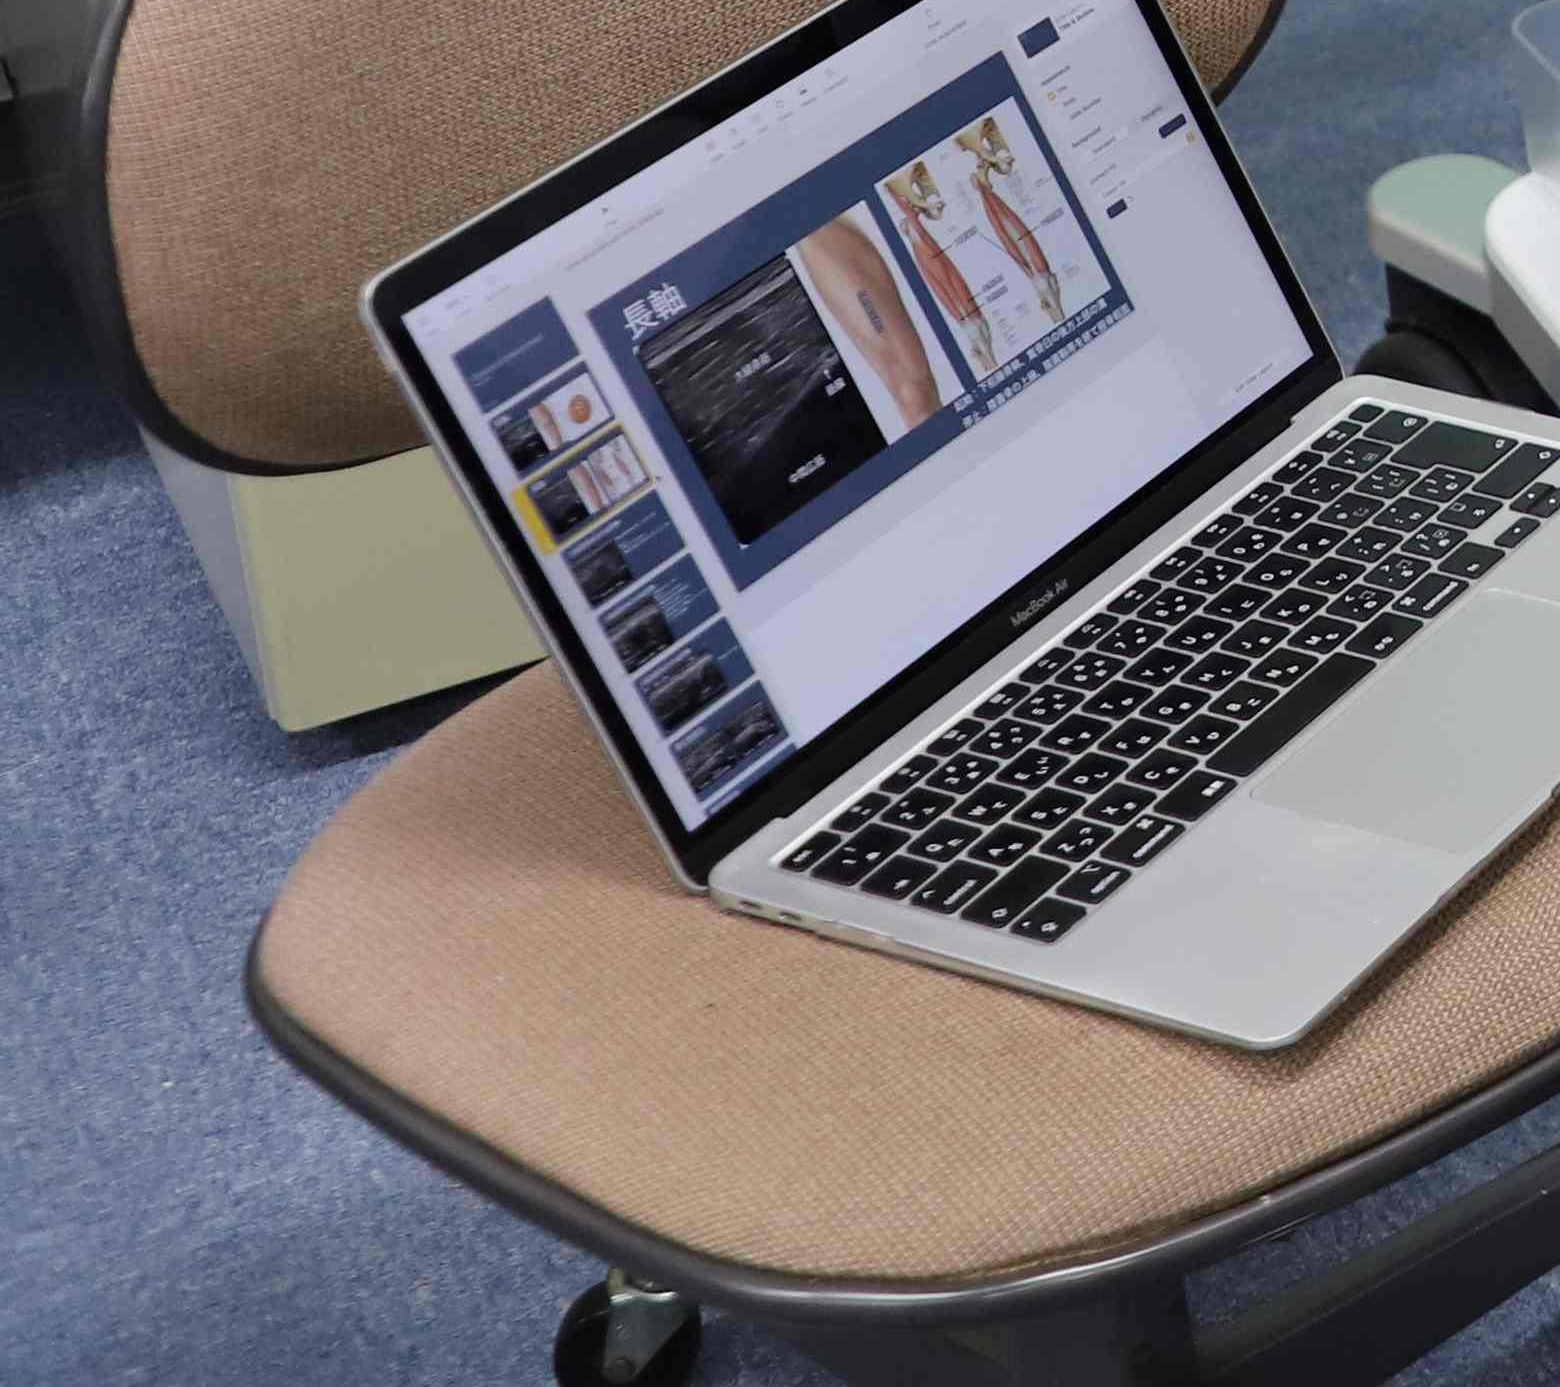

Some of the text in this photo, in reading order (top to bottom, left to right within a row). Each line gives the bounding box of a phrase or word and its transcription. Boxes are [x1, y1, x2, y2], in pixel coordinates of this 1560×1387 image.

[622, 282, 688, 340] 長軸
[899, 812, 915, 820] 2
[944, 776, 960, 784] 3
[1031, 707, 1046, 715] 5
[1114, 641, 1126, 649] 7
[1155, 609, 1169, 617] 8
[1194, 577, 1208, 585] 9
[925, 843, 943, 852] Q
[967, 805, 987, 816] W
[1014, 772, 1030, 780] E
[1057, 736, 1073, 745] R
[1181, 635, 1196, 644] U
[1260, 573, 1274, 581] O
[1297, 543, 1308, 551] P
[1010, 579, 1068, 626] MacBook Air
[988, 848, 1004, 856] A
[1030, 811, 1047, 820] S
[1073, 775, 1089, 784] D
[1115, 741, 1127, 749] F
[1158, 706, 1173, 715] G
[1198, 672, 1215, 682] H
[1241, 641, 1252, 649] J
[1277, 608, 1292, 617] K
[1057, 635, 1322, 852] Z X C V B N M
